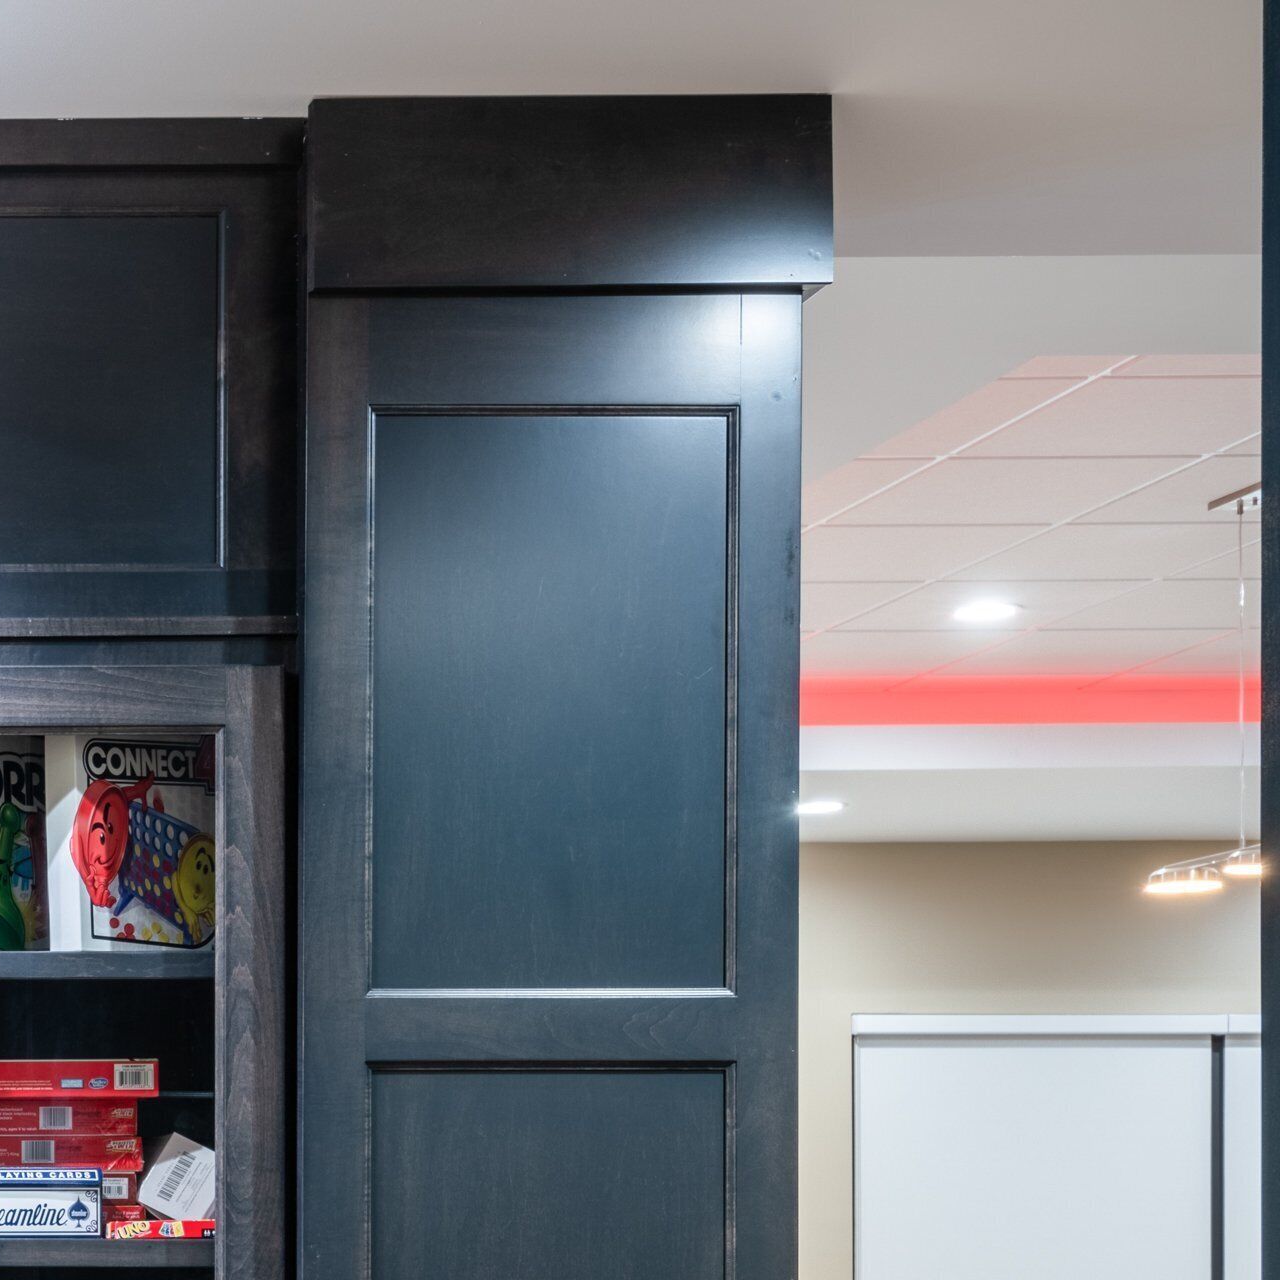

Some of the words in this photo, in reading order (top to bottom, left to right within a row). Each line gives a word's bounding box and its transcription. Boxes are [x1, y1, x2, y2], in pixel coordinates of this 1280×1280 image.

[87, 745, 197, 779] CONNECT
[49, 1171, 92, 1179] CARDS
[117, 1221, 150, 1239] UNO
